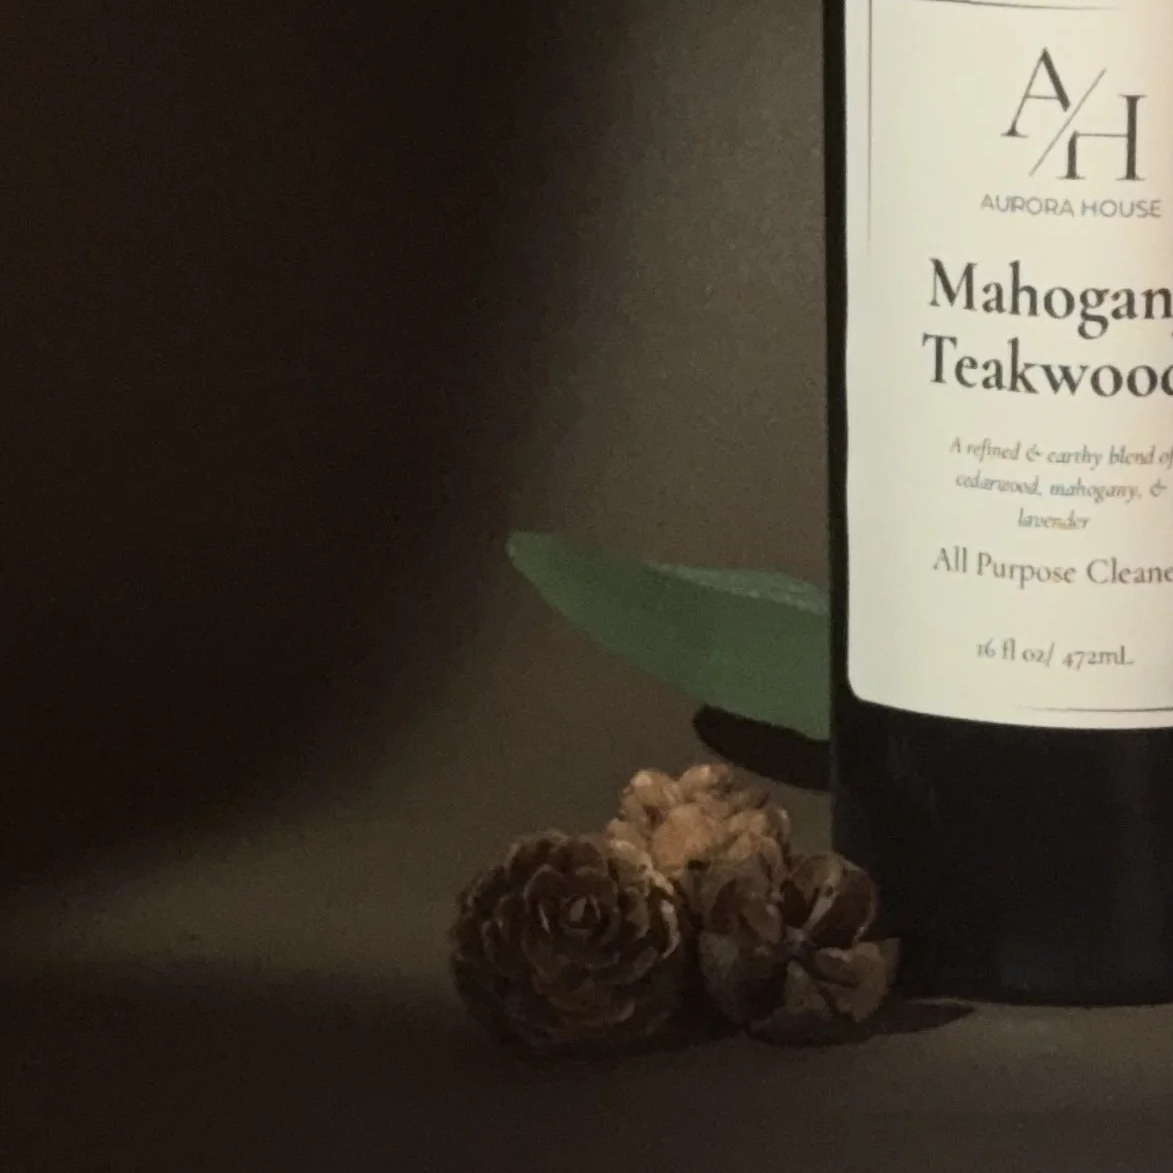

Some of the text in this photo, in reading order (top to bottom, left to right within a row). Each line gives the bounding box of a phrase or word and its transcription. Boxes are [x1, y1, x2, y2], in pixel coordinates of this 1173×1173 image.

[980, 194, 1163, 218] AURORA HOUSE
[949, 436, 961, 453] A
[966, 437, 1020, 462] refined
[1025, 443, 1042, 463] &
[1047, 444, 1103, 470] earthy
[1108, 444, 1155, 465] blend
[955, 470, 1167, 504] cedarwood, mahogany, &
[1018, 508, 1091, 530] lavender
[932, 546, 968, 574] All
[977, 552, 1077, 589] Purpose
[976, 638, 996, 658] 16
[1002, 638, 1016, 660] fl
[1062, 644, 1135, 670] 472mL
